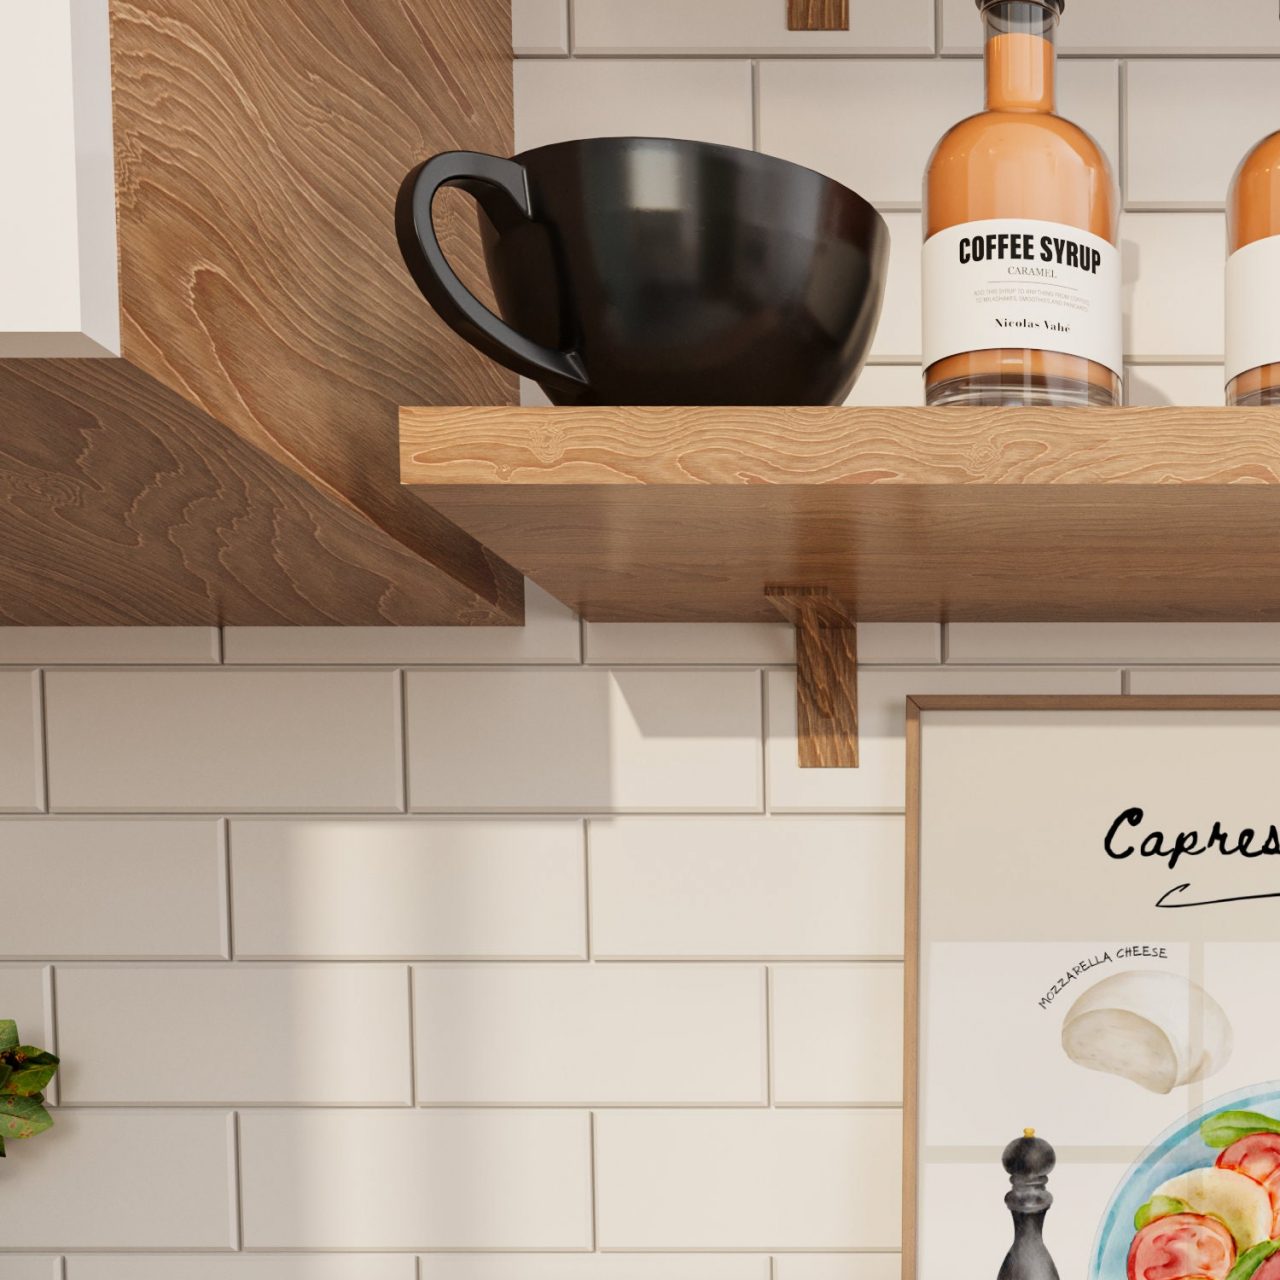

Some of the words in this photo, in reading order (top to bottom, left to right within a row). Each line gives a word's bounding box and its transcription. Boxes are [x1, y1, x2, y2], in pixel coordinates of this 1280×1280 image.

[959, 233, 1035, 264] COFFEE
[1040, 235, 1101, 275] SYRUP
[1007, 265, 1058, 279] CARAMEL
[994, 318, 1040, 328] Nicolas
[1038, 951, 1113, 1010] MOZZARELLA
[1116, 945, 1168, 959] CHEESE
